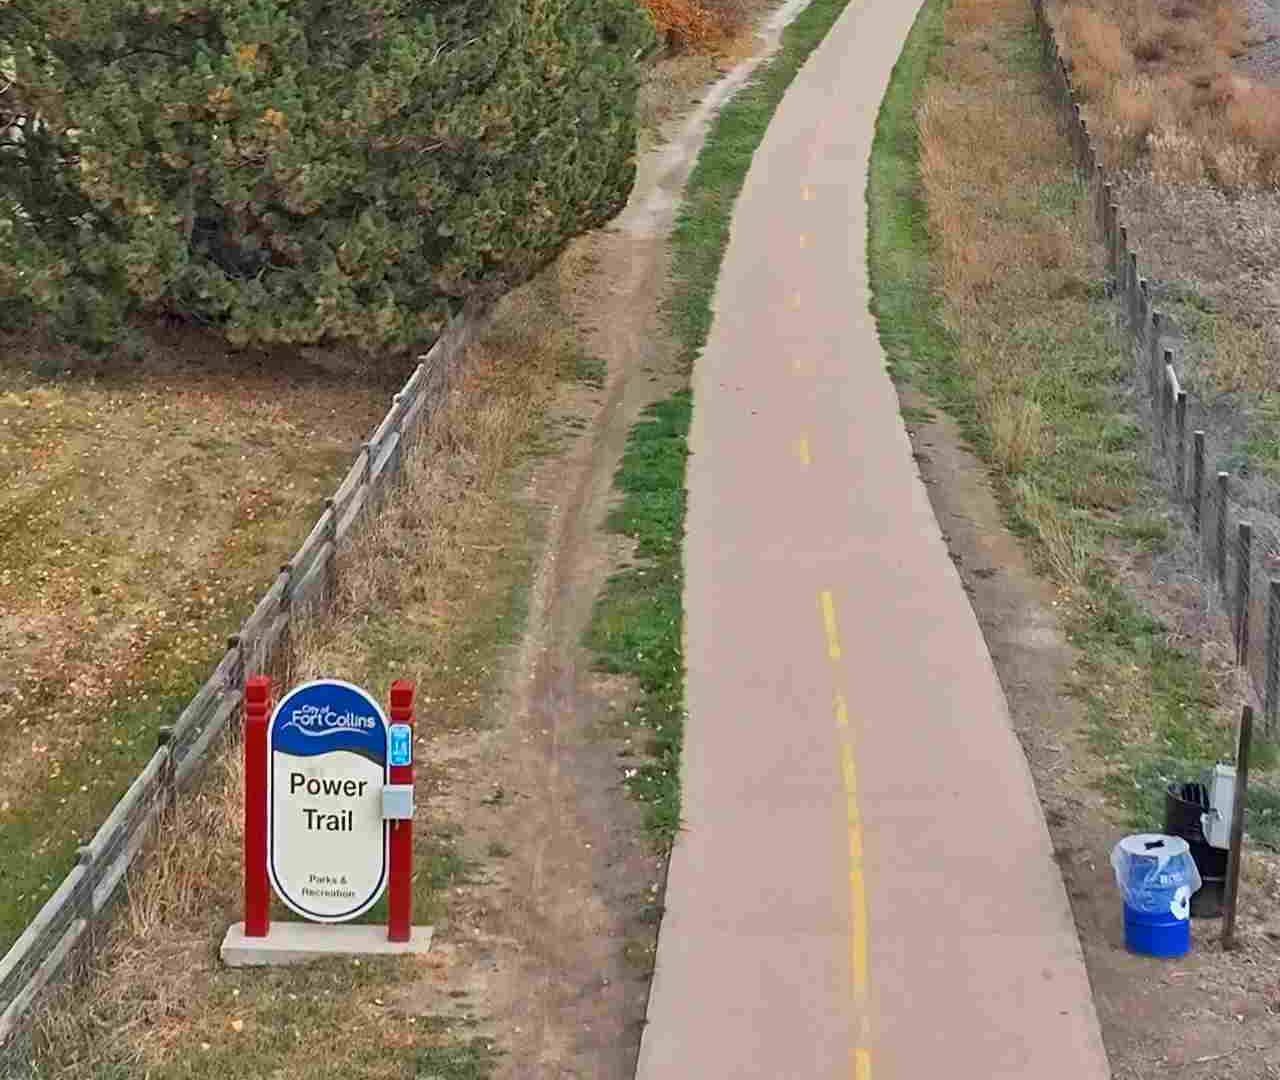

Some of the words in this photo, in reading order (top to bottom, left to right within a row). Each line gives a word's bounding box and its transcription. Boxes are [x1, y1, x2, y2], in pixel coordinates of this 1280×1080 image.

[292, 710, 322, 726] Fort
[324, 711, 376, 728] Collins
[290, 772, 368, 797] Power
[302, 808, 353, 831] Trail
[309, 874, 337, 885] Parks
